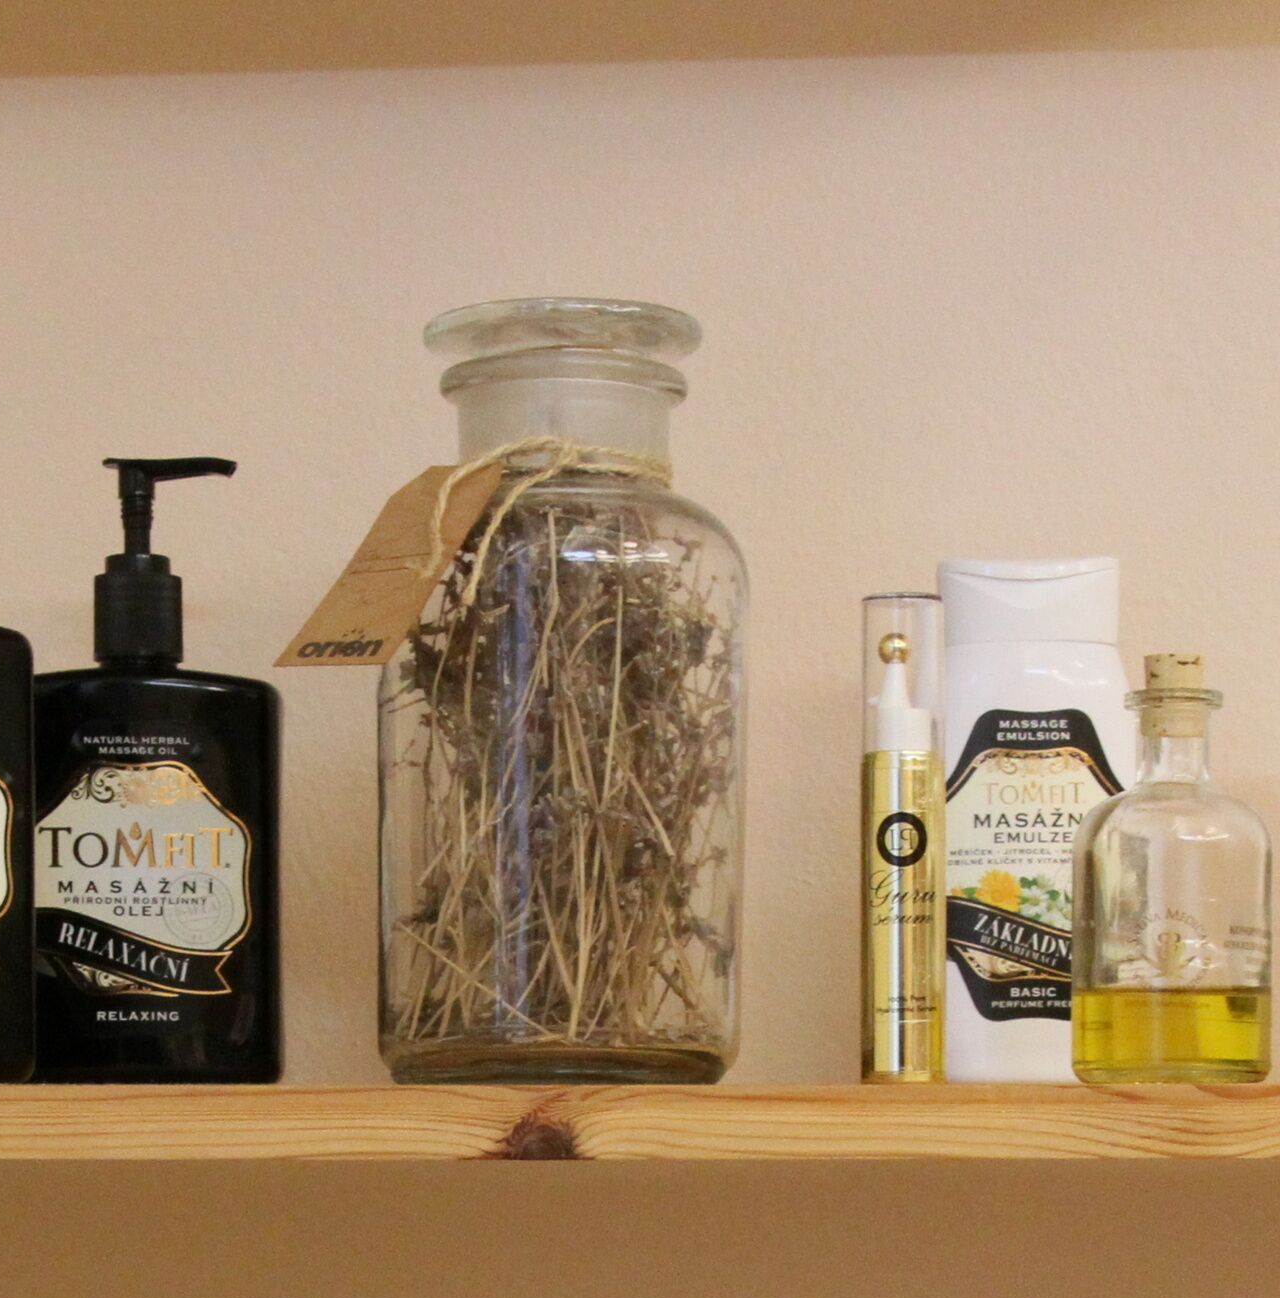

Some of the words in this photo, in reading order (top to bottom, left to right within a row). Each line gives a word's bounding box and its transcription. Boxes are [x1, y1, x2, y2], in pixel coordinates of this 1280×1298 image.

[998, 719, 1068, 729] MASSAGE
[83, 736, 138, 745] NATURAL
[141, 736, 190, 745] HERBAL
[996, 731, 1071, 741] EMULSION
[98, 746, 155, 755] MASSAGE
[158, 747, 178, 755] OIL
[974, 808, 1084, 829] MASÁŽN
[994, 831, 1073, 844] EMULZE
[58, 877, 213, 895] MASÁŽNÍ
[63, 896, 127, 905] PŘÍRODNÍ
[133, 896, 207, 905] ROSTLINNÝ
[113, 905, 164, 917] OLEJ
[58, 922, 190, 983] RELAXAČNÍ
[1010, 987, 1057, 998] BASIC
[991, 1001, 1044, 1009] PERFUME
[96, 1011, 180, 1022] RELAXING
